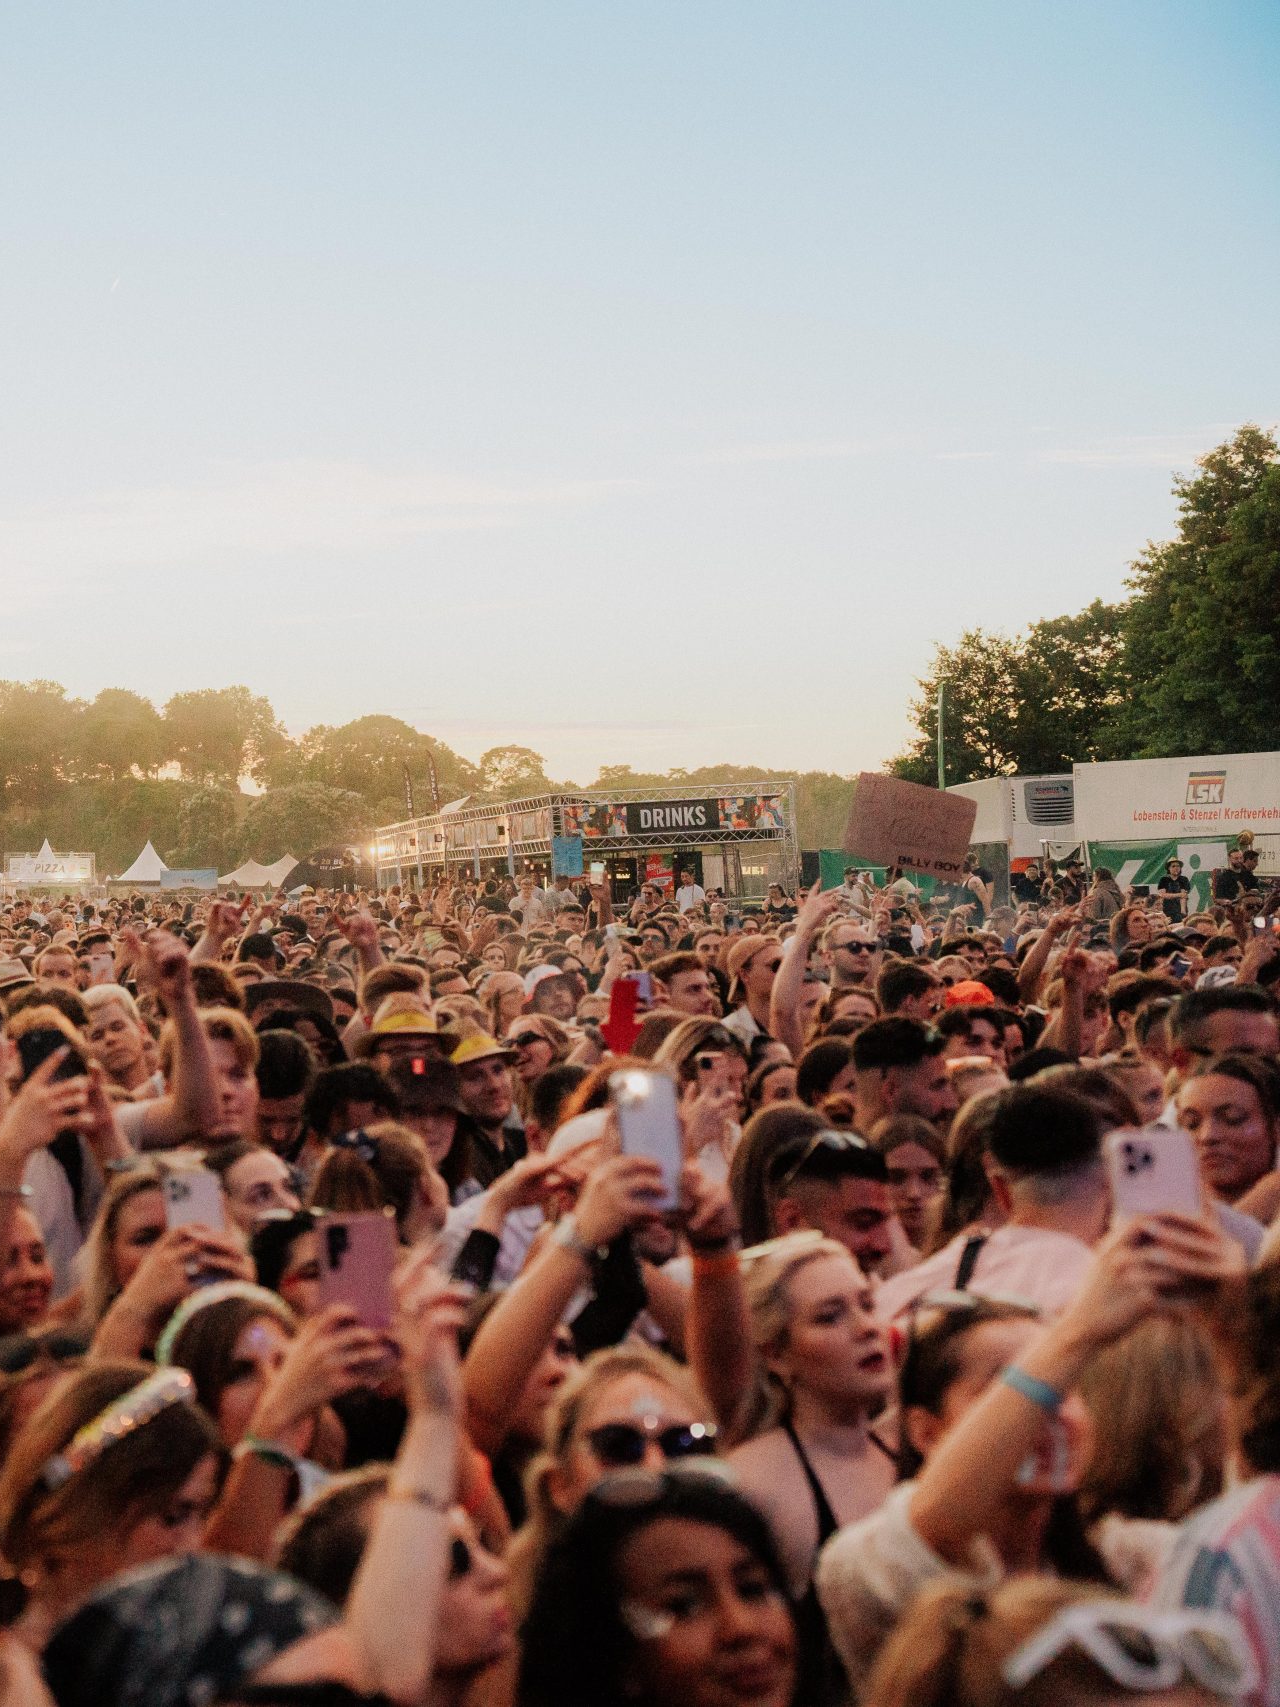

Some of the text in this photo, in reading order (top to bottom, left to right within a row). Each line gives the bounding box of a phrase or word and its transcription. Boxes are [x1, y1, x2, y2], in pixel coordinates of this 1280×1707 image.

[1186, 784, 1222, 802] LSK
[640, 805, 707, 829] DRINKS
[1133, 809, 1178, 821] Lobenstein
[1180, 809, 1186, 820] &
[1189, 808, 1221, 820] Stenzel
[34, 863, 65, 873] PIZZA
[898, 856, 960, 872] BILLY BOY
